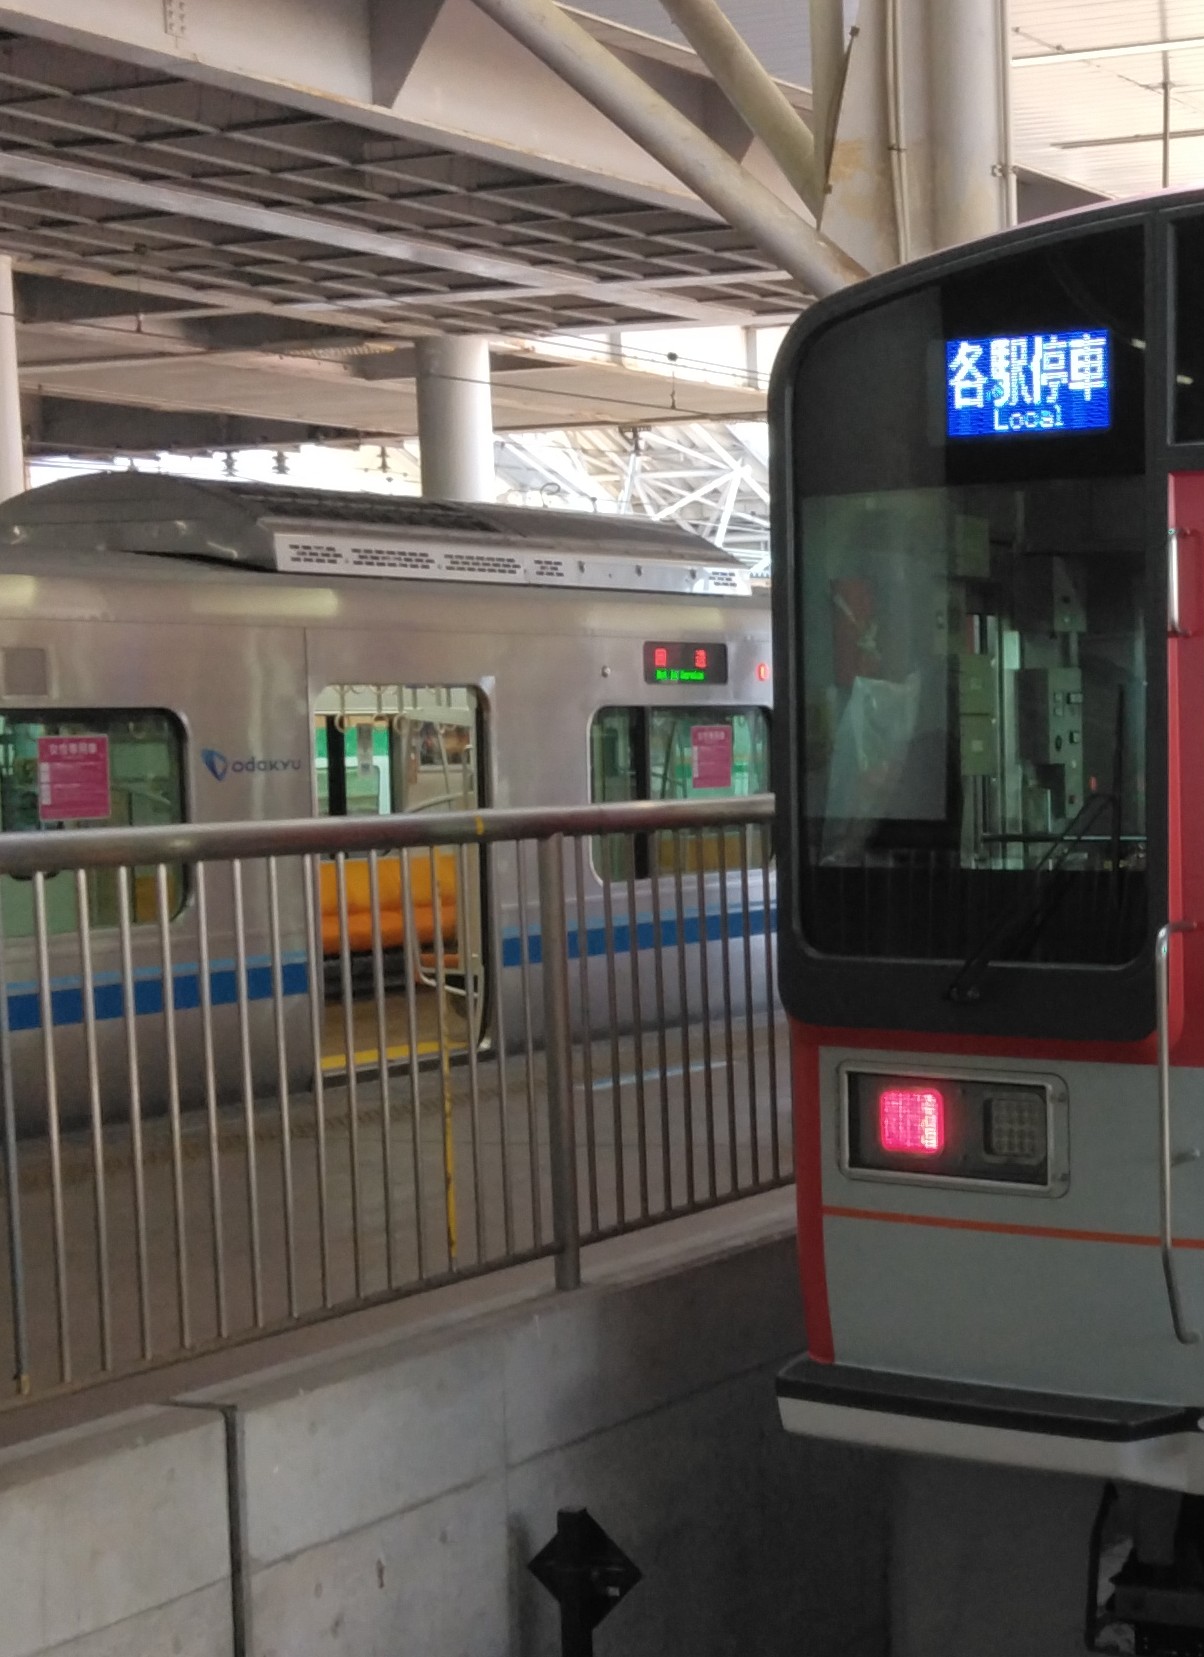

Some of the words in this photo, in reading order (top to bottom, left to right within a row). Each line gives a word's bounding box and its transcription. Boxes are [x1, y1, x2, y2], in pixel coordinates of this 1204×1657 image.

[948, 333, 1107, 410] 各駅停車
[993, 403, 1064, 431] Local
